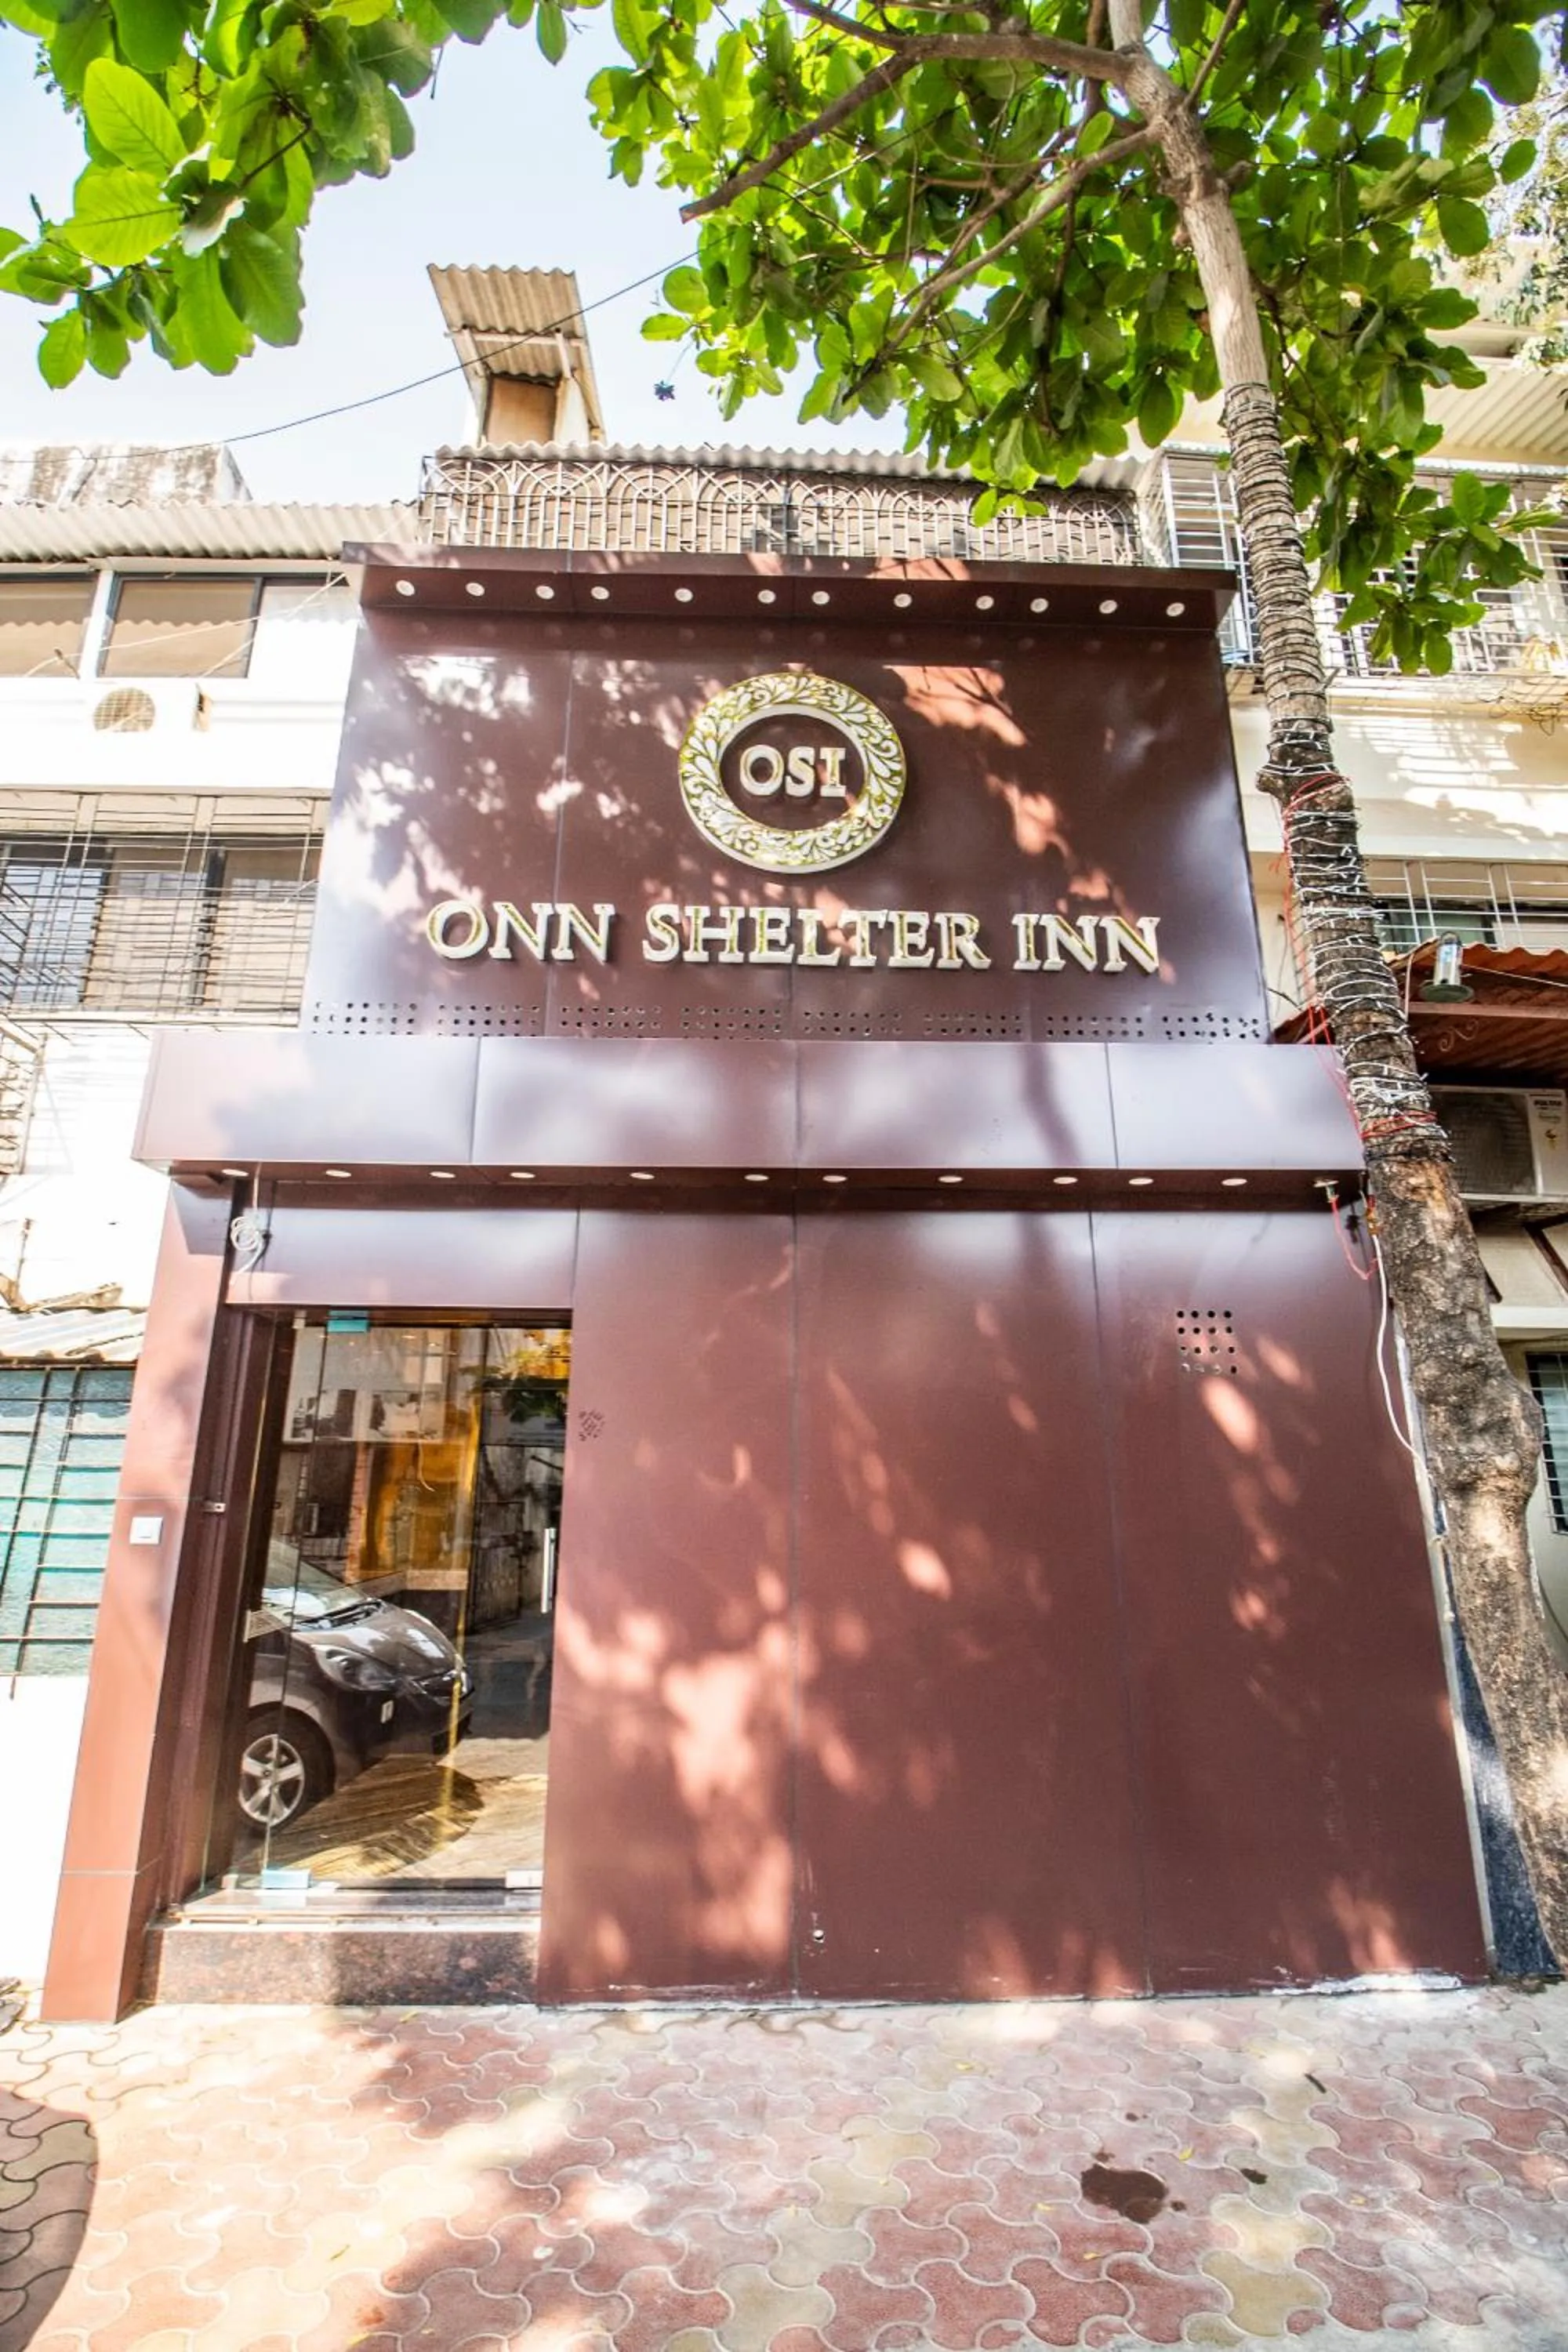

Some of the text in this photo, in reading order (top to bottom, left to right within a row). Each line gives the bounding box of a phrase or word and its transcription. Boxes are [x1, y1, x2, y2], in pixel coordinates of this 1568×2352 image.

[739, 745, 847, 797] OSI
[426, 900, 1161, 974] ONN SHELTER INN
